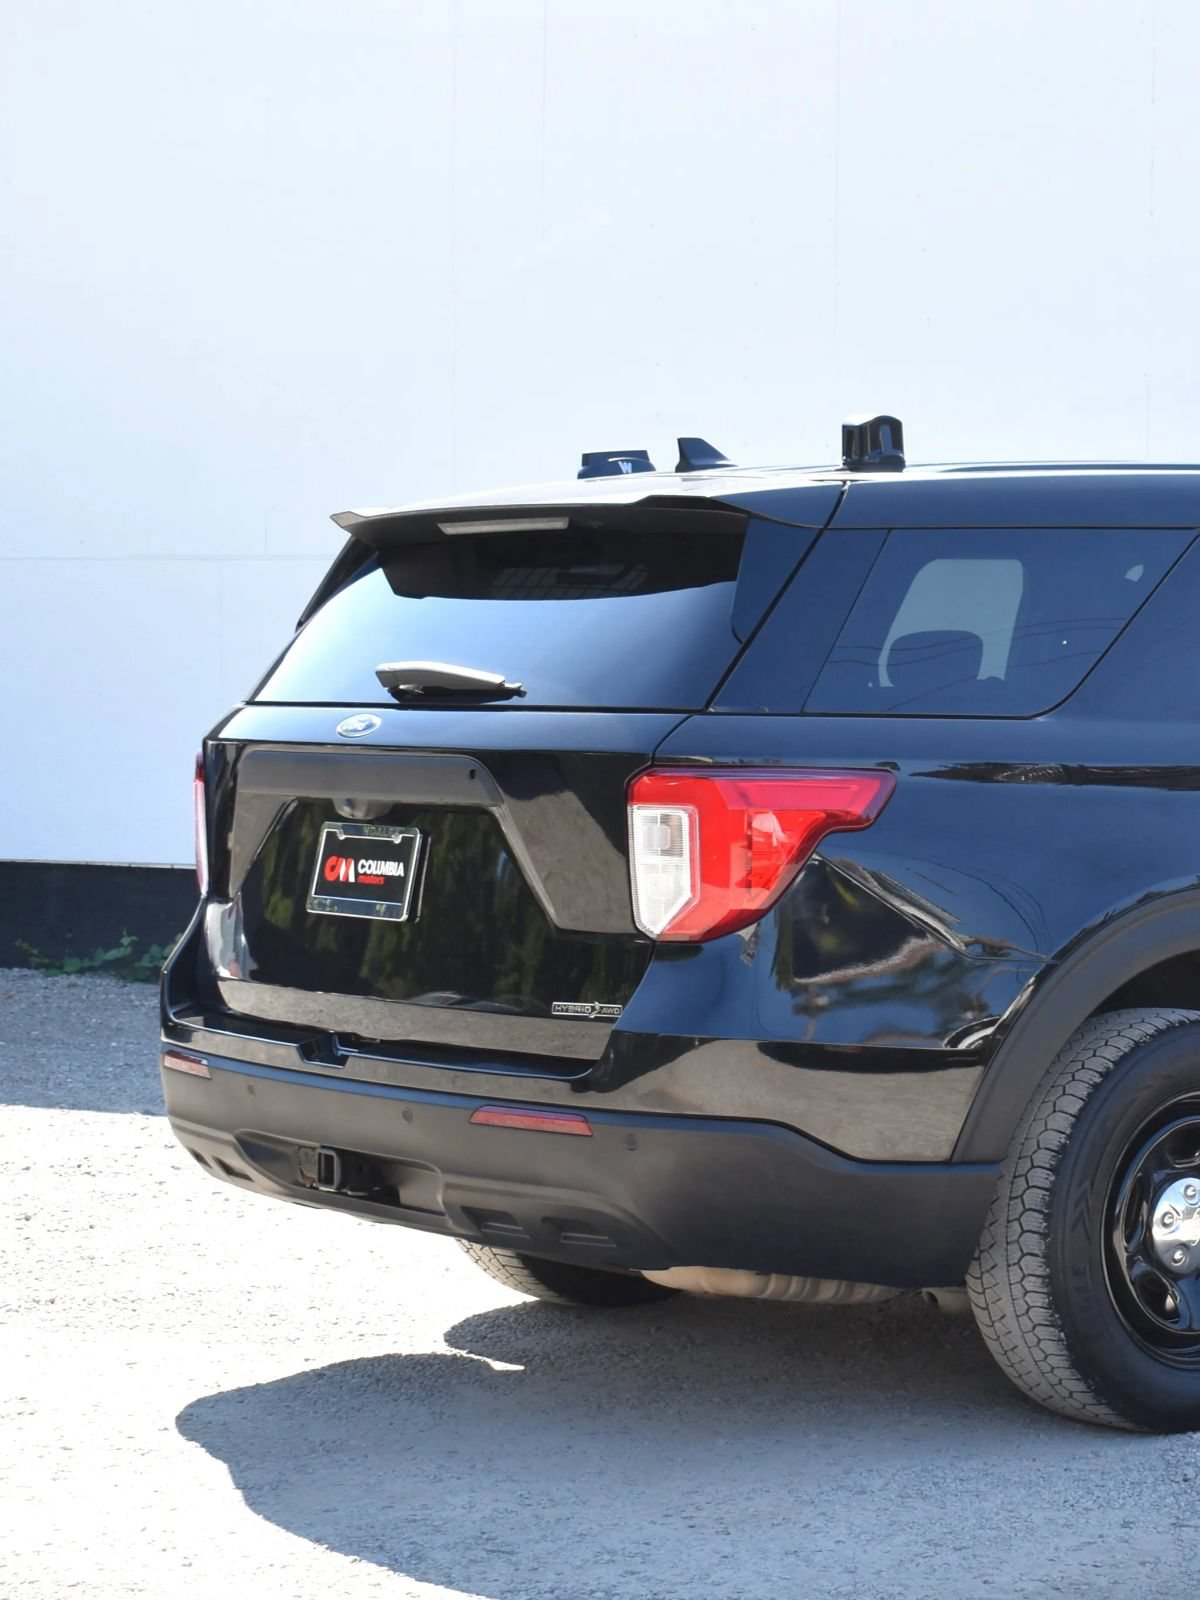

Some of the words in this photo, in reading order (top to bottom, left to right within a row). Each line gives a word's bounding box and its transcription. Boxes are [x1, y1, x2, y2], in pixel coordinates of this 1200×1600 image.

[358, 859, 404, 877] COLUMBIA
[554, 1004, 592, 1014] HYBRID
[601, 1007, 620, 1015] AWD
